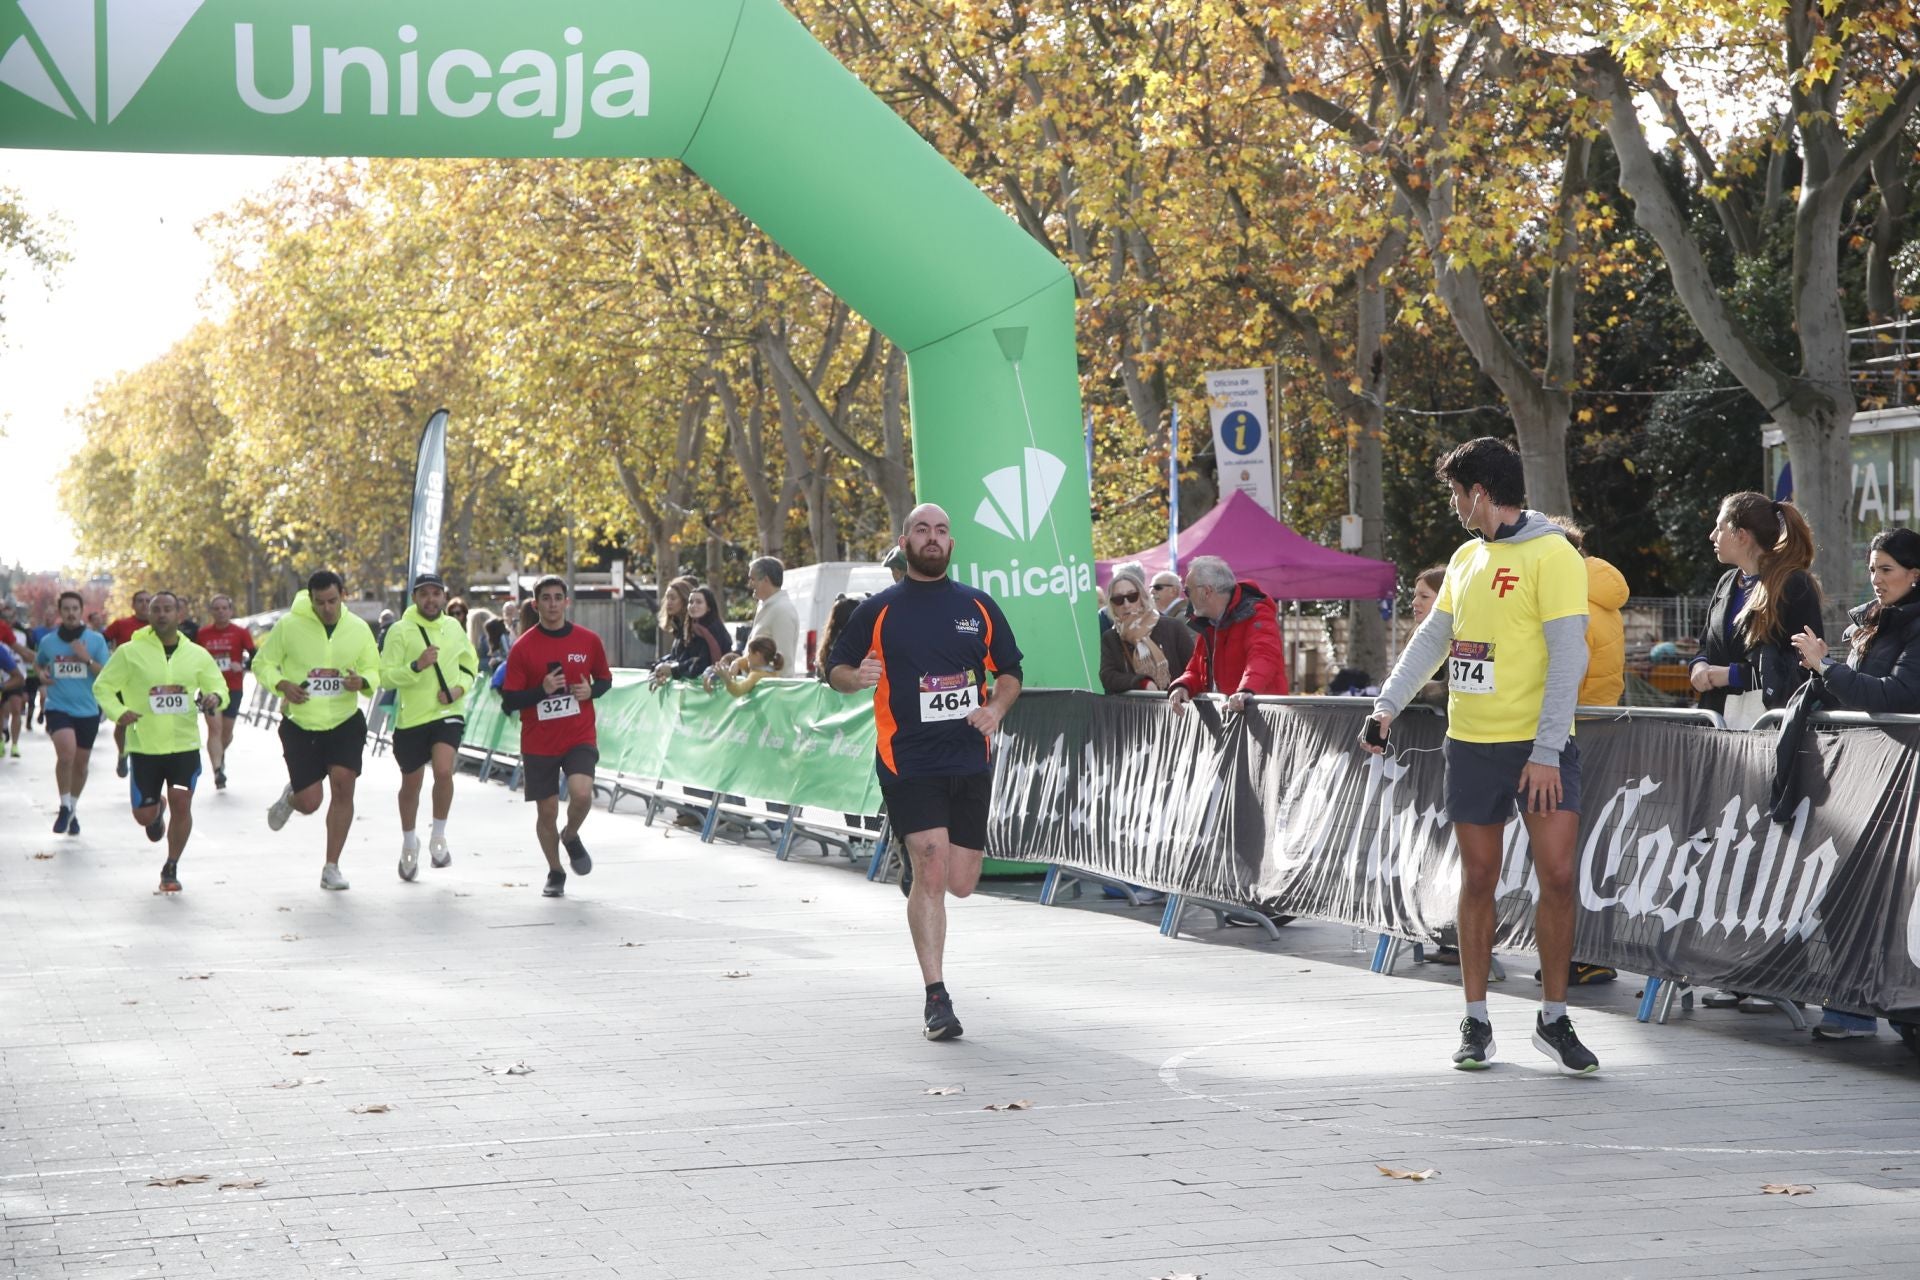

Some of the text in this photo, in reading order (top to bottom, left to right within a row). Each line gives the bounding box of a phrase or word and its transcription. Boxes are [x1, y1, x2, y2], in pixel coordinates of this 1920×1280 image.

[234, 22, 651, 139] Unicaja
[59, 663, 82, 673] 206
[1452, 660, 1484, 683] 374
[313, 679, 340, 691] 208
[156, 696, 183, 708] 209
[542, 697, 571, 713] 327
[929, 690, 971, 711] 464
[1580, 775, 1840, 945] Castilla
